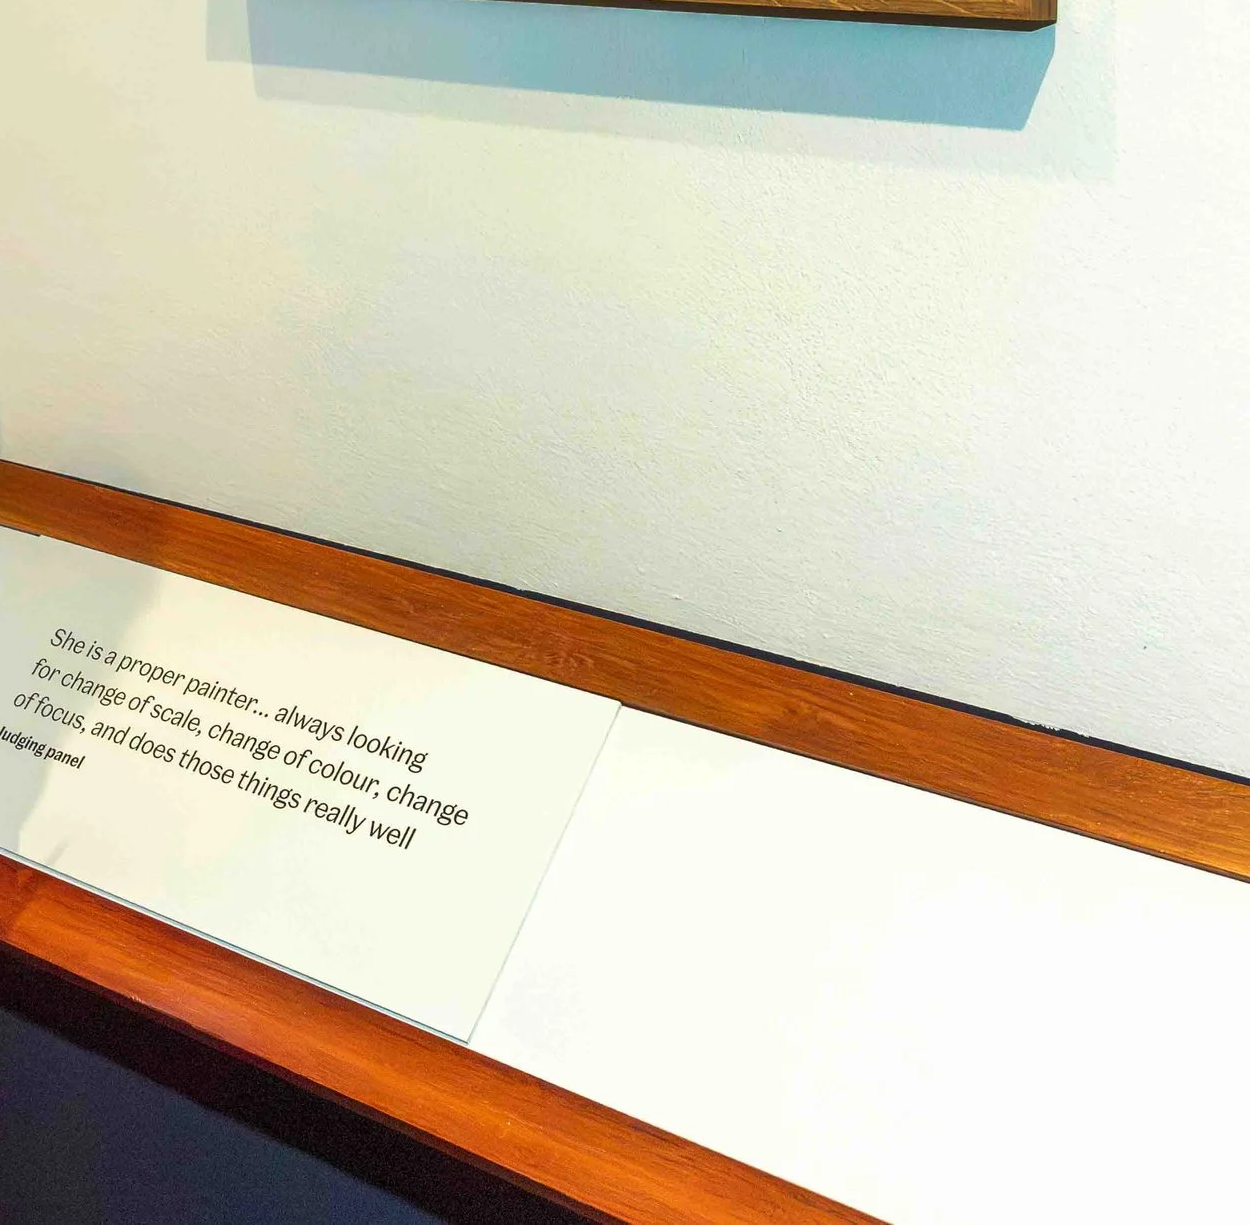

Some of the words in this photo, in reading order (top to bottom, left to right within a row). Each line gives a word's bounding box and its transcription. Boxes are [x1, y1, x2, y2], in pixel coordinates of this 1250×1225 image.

[13, 692, 40, 710] of
[33, 696, 86, 734] focus,
[90, 720, 131, 746] and
[128, 732, 177, 763] does
[178, 748, 235, 786] those
[237, 770, 302, 809] things
[303, 797, 367, 835] really
[369, 819, 417, 850] well
[31, 658, 61, 682] for
[60, 670, 127, 707] change
[128, 695, 155, 714] of
[150, 703, 203, 737] scale,
[207, 722, 281, 760] change
[283, 749, 313, 769] of
[308, 758, 380, 799] colour,
[386, 784, 469, 826] change
[44, 743, 86, 769] panel
[50, 628, 85, 654] She
[86, 641, 103, 661] is
[104, 651, 118, 665] a
[115, 654, 186, 686] proper
[274, 705, 345, 741] always
[346, 725, 429, 774] looking
